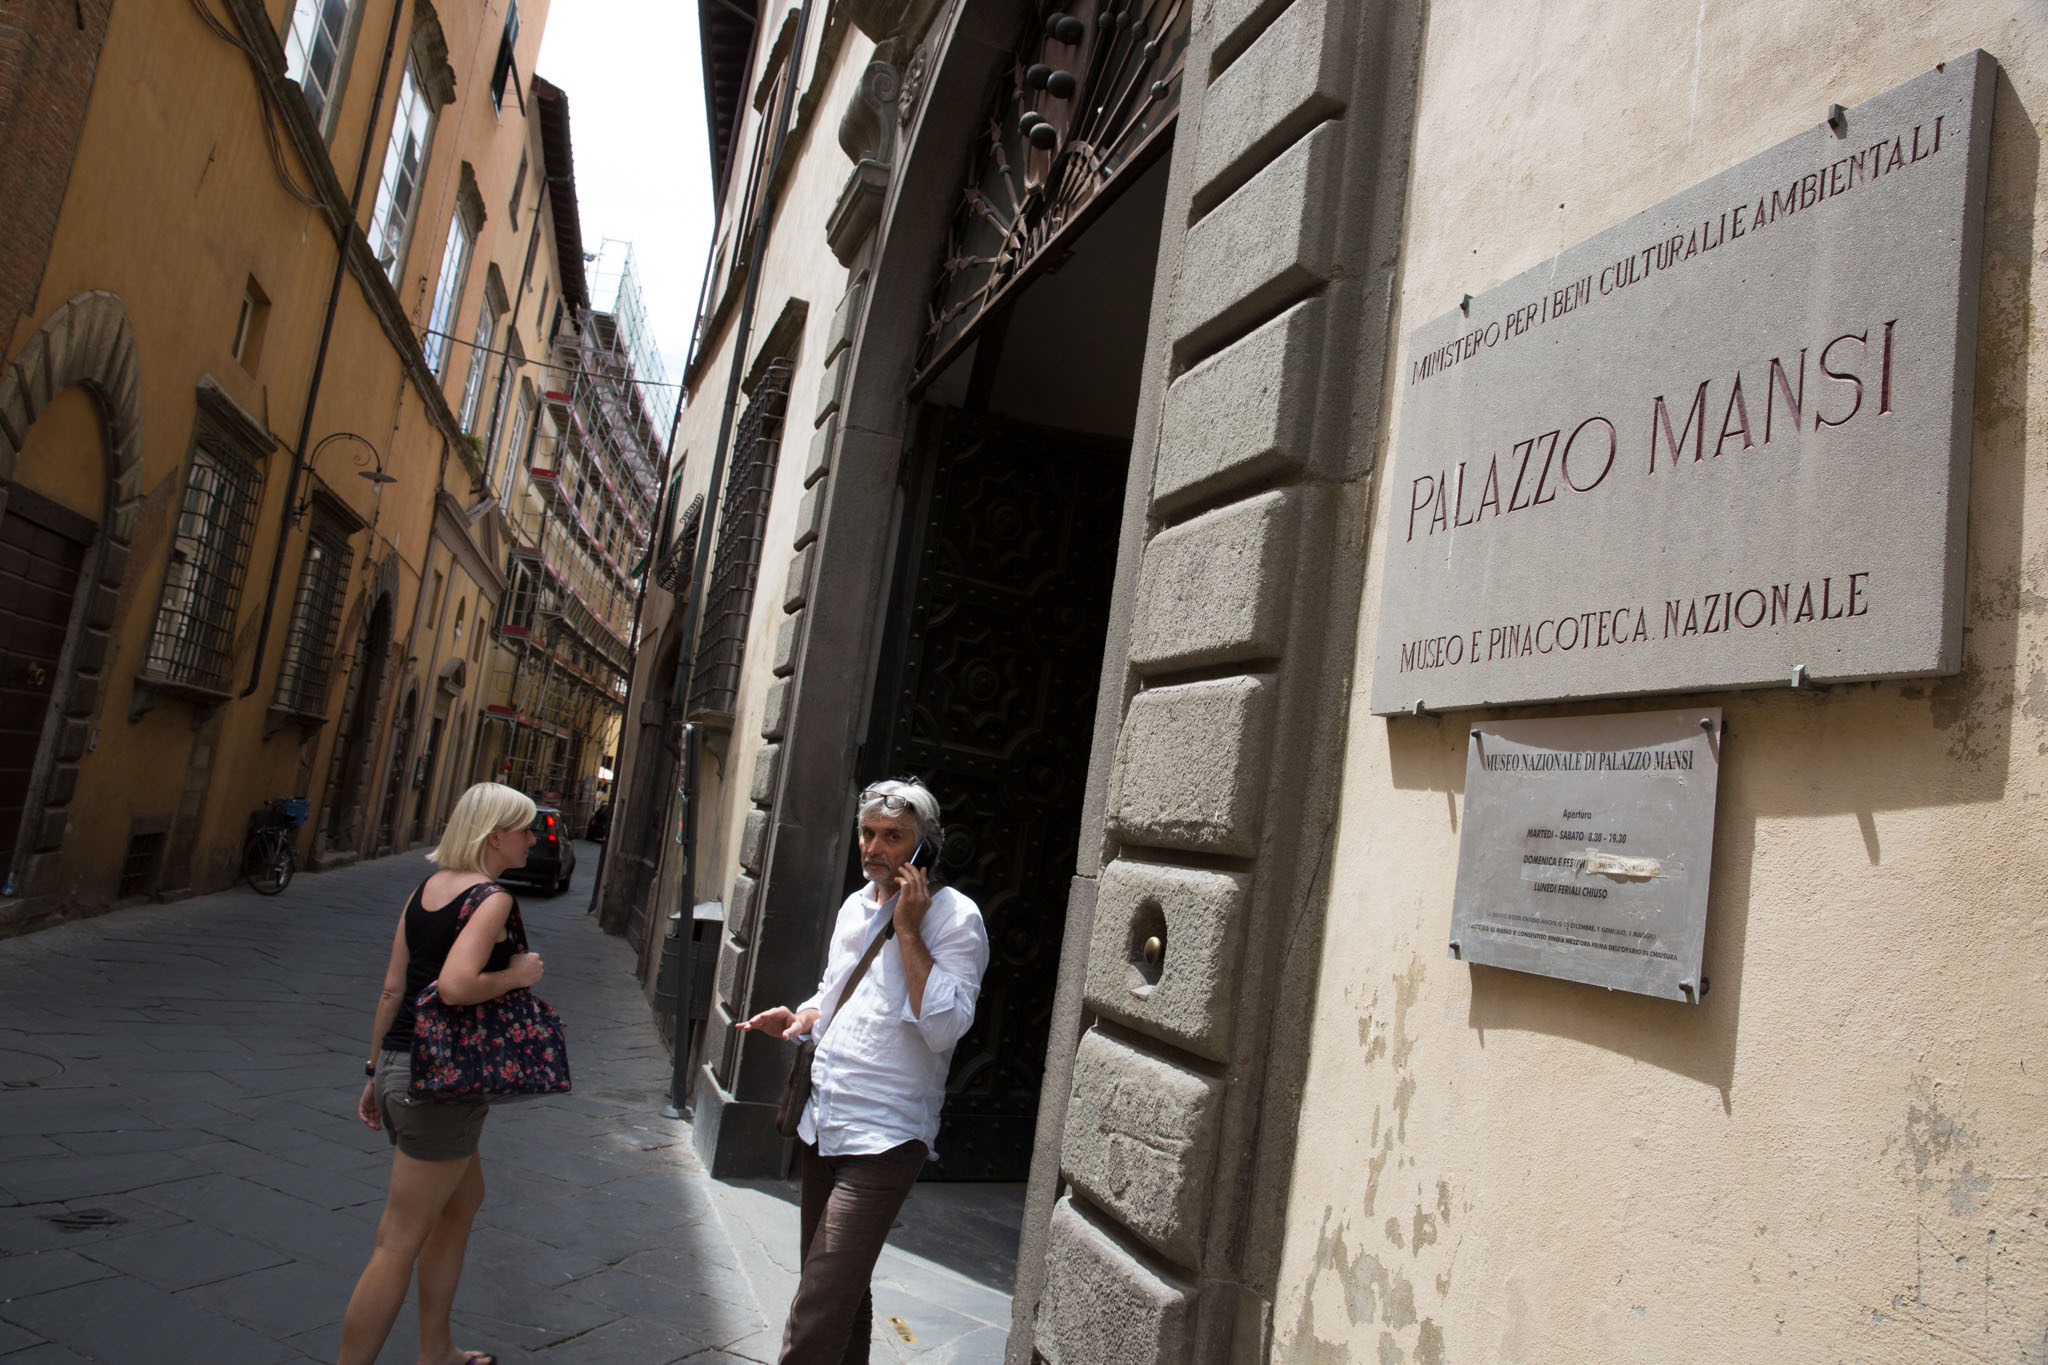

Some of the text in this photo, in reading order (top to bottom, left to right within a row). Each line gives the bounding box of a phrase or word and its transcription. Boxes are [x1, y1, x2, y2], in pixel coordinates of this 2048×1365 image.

[1412, 115, 1944, 386] MINISTERO PER I BENI CULTURALI E AMBIENTALI
[1407, 318, 1899, 543] PALAZZO MANSI
[1400, 572, 1870, 674] MUSEO E PINACOTECA NAZIONALE
[1486, 750, 1694, 771] MUSEO NAZIONALE DI PALAZZO MANSI
[1563, 809, 1592, 820] Apertura
[1559, 831, 1584, 842] SABATO
[1587, 832, 1602, 843] 8.30
[1608, 833, 1627, 845] 19.30
[1523, 855, 1556, 867] DOMENICA
[1558, 858, 1562, 867] E
[1534, 881, 1608, 900] LUNEDI FERIALI CHIUSO
[1523, 916, 1539, 924] CHIUSO
[1540, 918, 1556, 926] ANCHE
[1518, 931, 1547, 941] CONSENTITO
[1548, 935, 1560, 943] FINO
[1591, 942, 1607, 950] PRIMA
[1649, 950, 1678, 960] CHIUSURA
